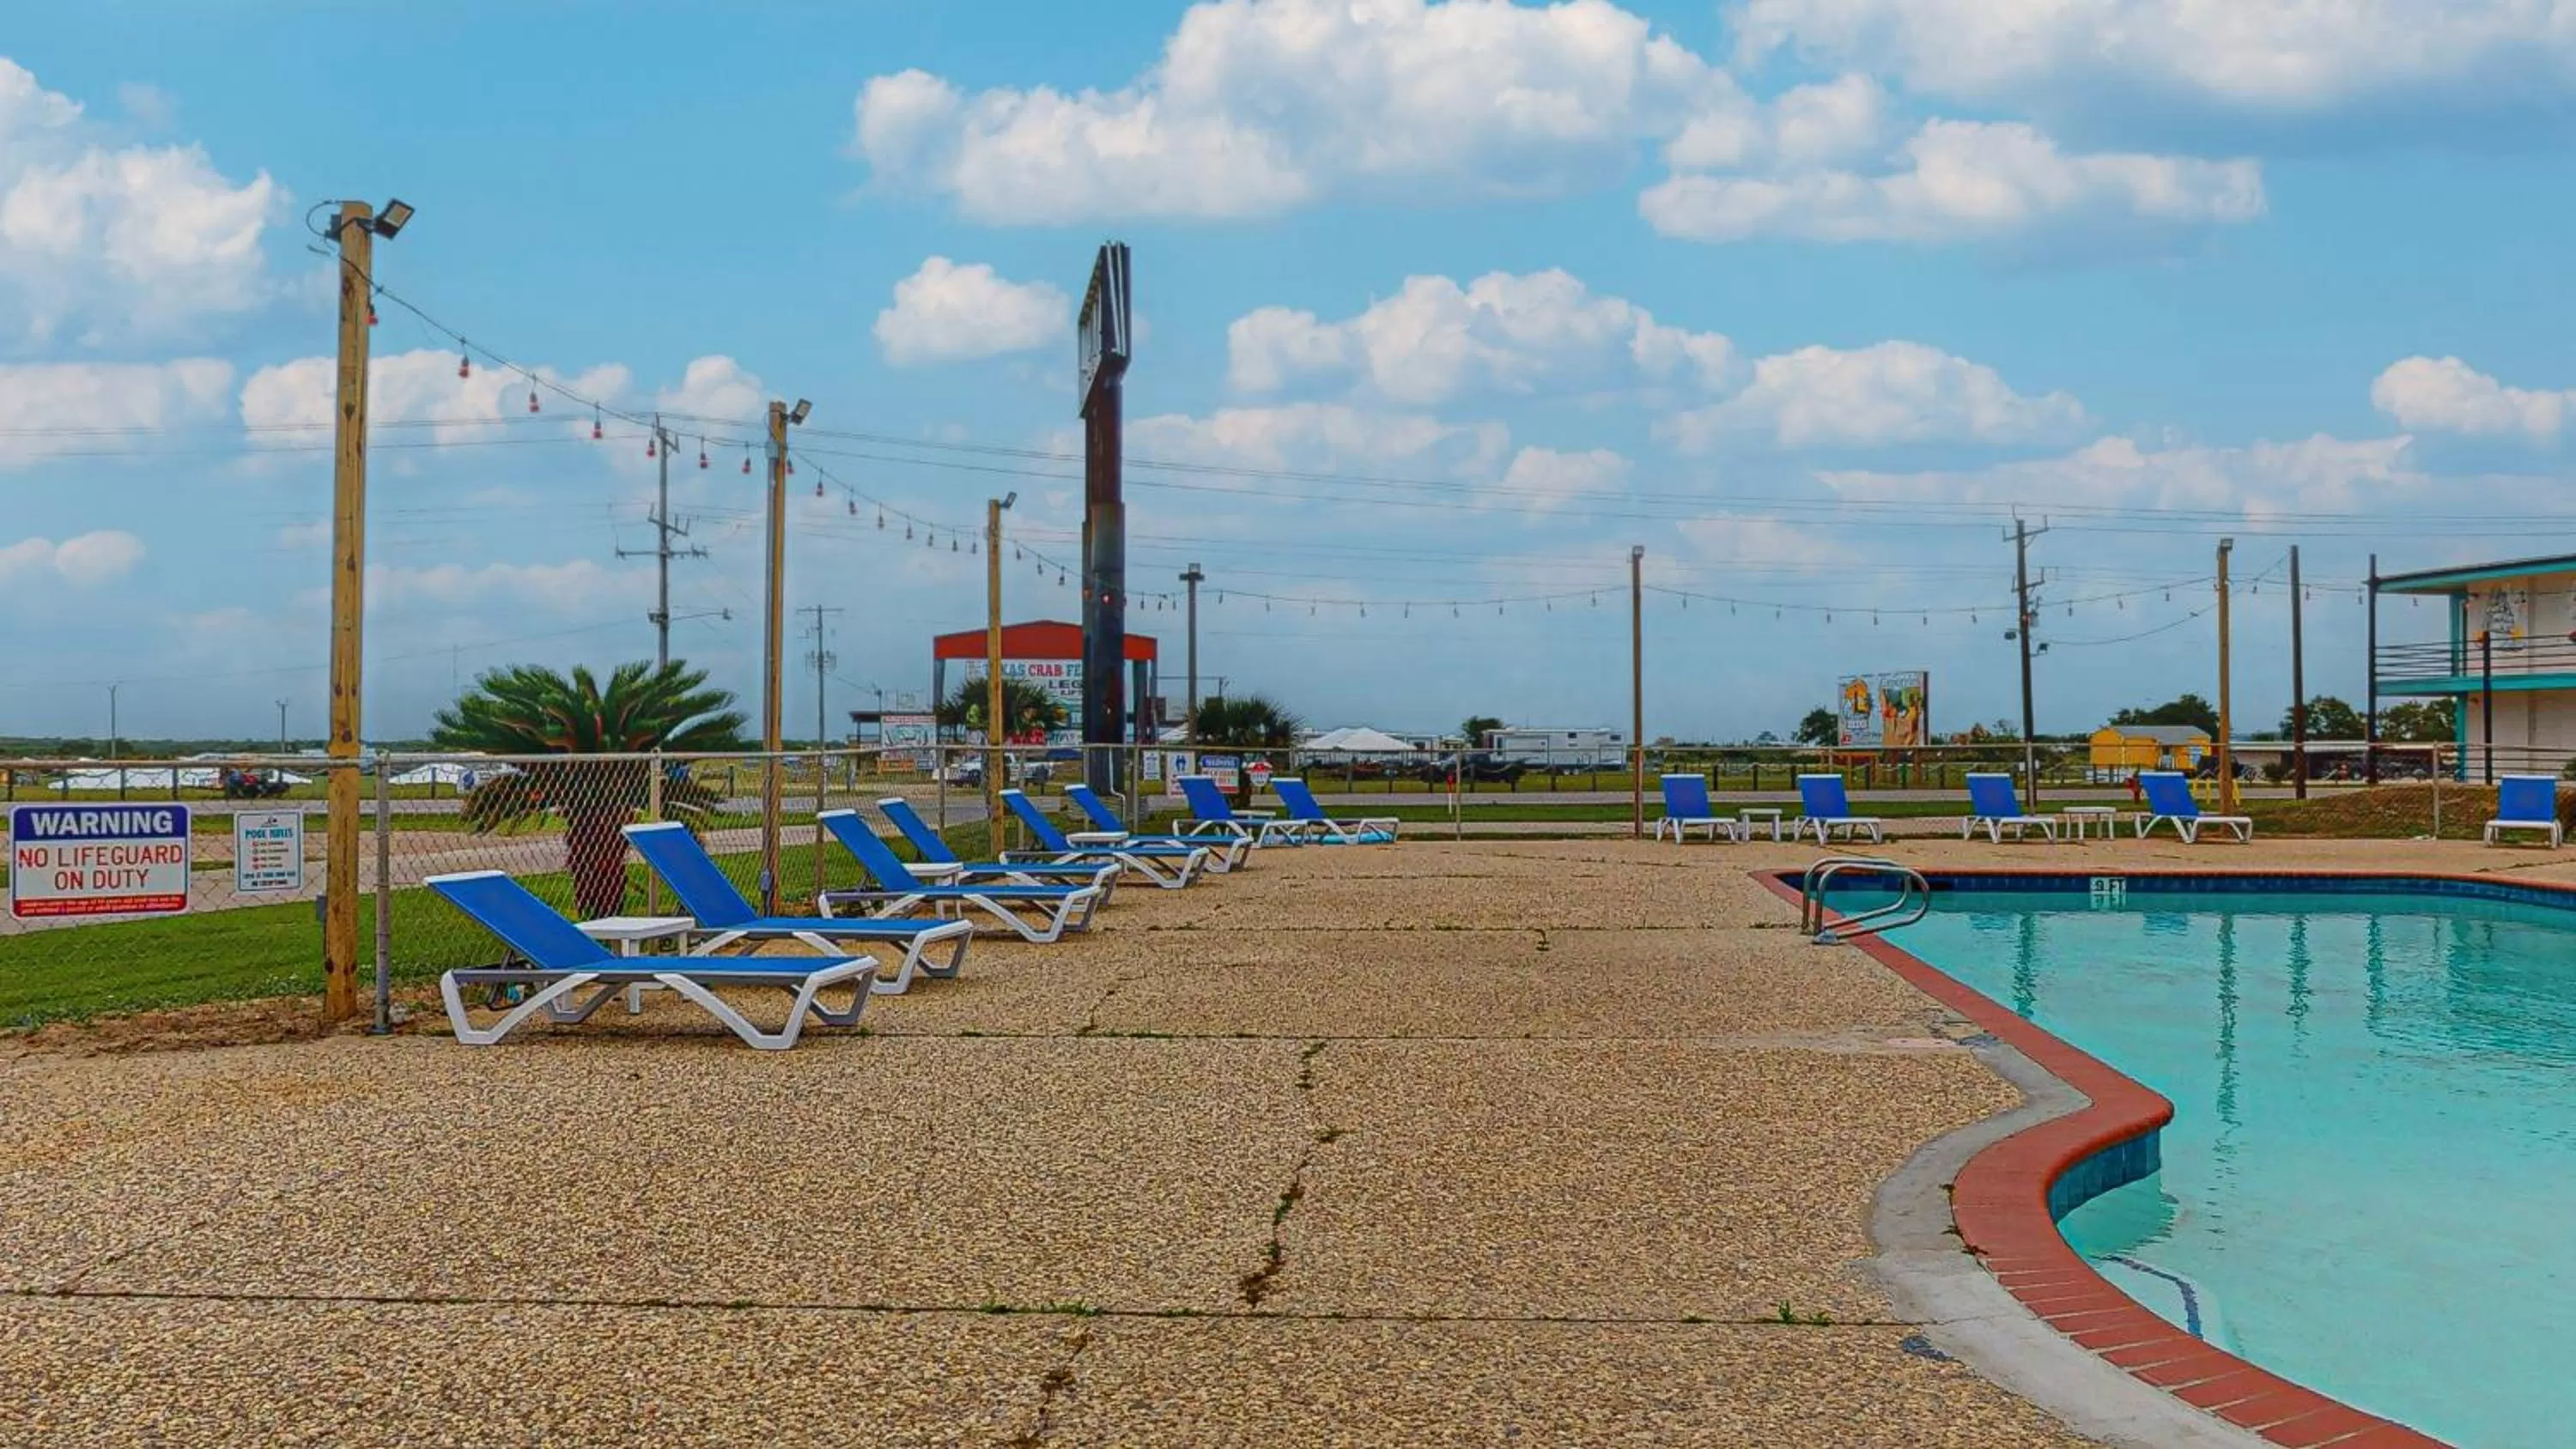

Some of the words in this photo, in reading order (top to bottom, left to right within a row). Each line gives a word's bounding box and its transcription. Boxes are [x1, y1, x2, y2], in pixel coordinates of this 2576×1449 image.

[982, 663, 1025, 676] TXAS
[1028, 663, 1063, 676] CRAB
[1066, 664, 1082, 676] FE
[31, 810, 173, 836] WARNING
[18, 847, 49, 868] NO
[58, 844, 183, 867] LIFEGUARD
[54, 870, 83, 890] ON
[93, 869, 149, 889] DUTY
[2108, 878, 2125, 892] FT
